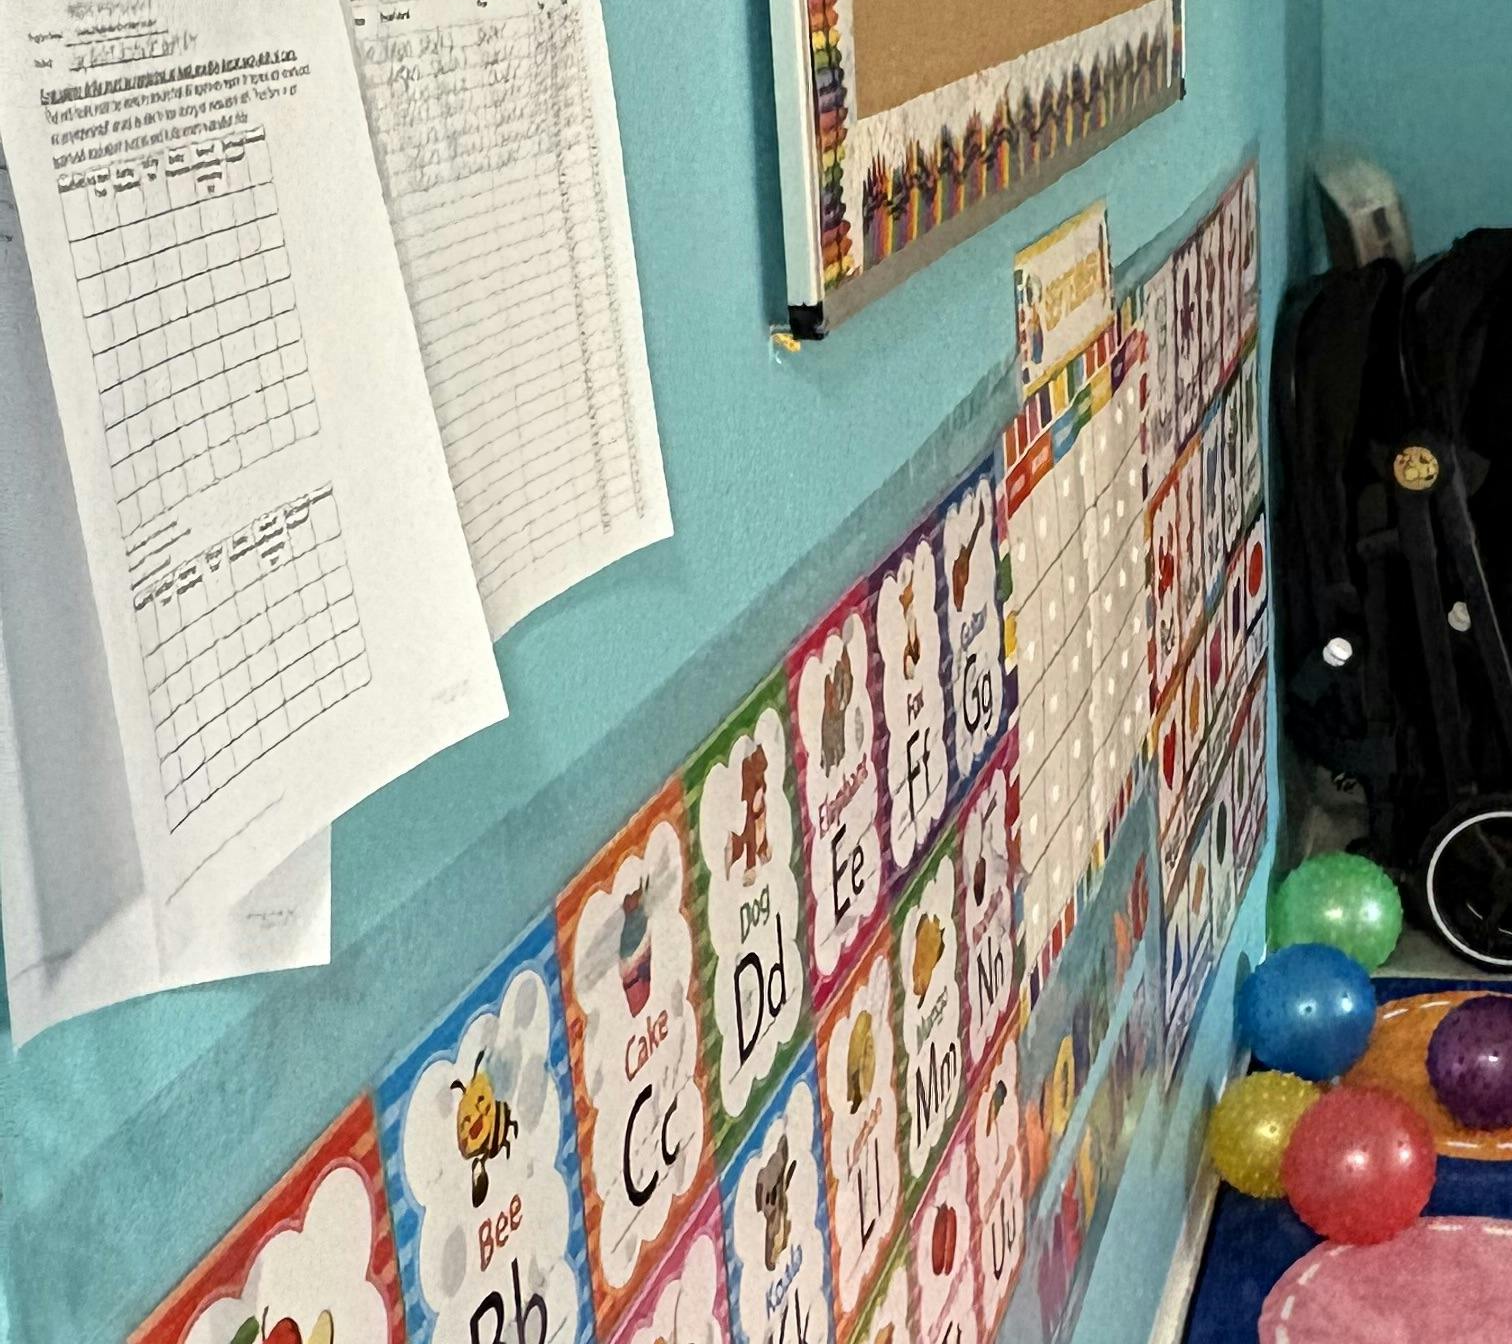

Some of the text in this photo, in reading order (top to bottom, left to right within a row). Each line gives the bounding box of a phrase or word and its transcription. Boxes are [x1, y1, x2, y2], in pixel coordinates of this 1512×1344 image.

[963, 653, 993, 734] Gg
[740, 884, 771, 944] Dog
[831, 823, 865, 928] Ee
[734, 912, 787, 1066] Dd
[978, 936, 1005, 1026] Nn
[624, 1008, 669, 1082] Cake
[622, 1083, 681, 1208] Cc
[478, 1193, 524, 1273] Bee
[992, 1197, 1016, 1280] Uu
